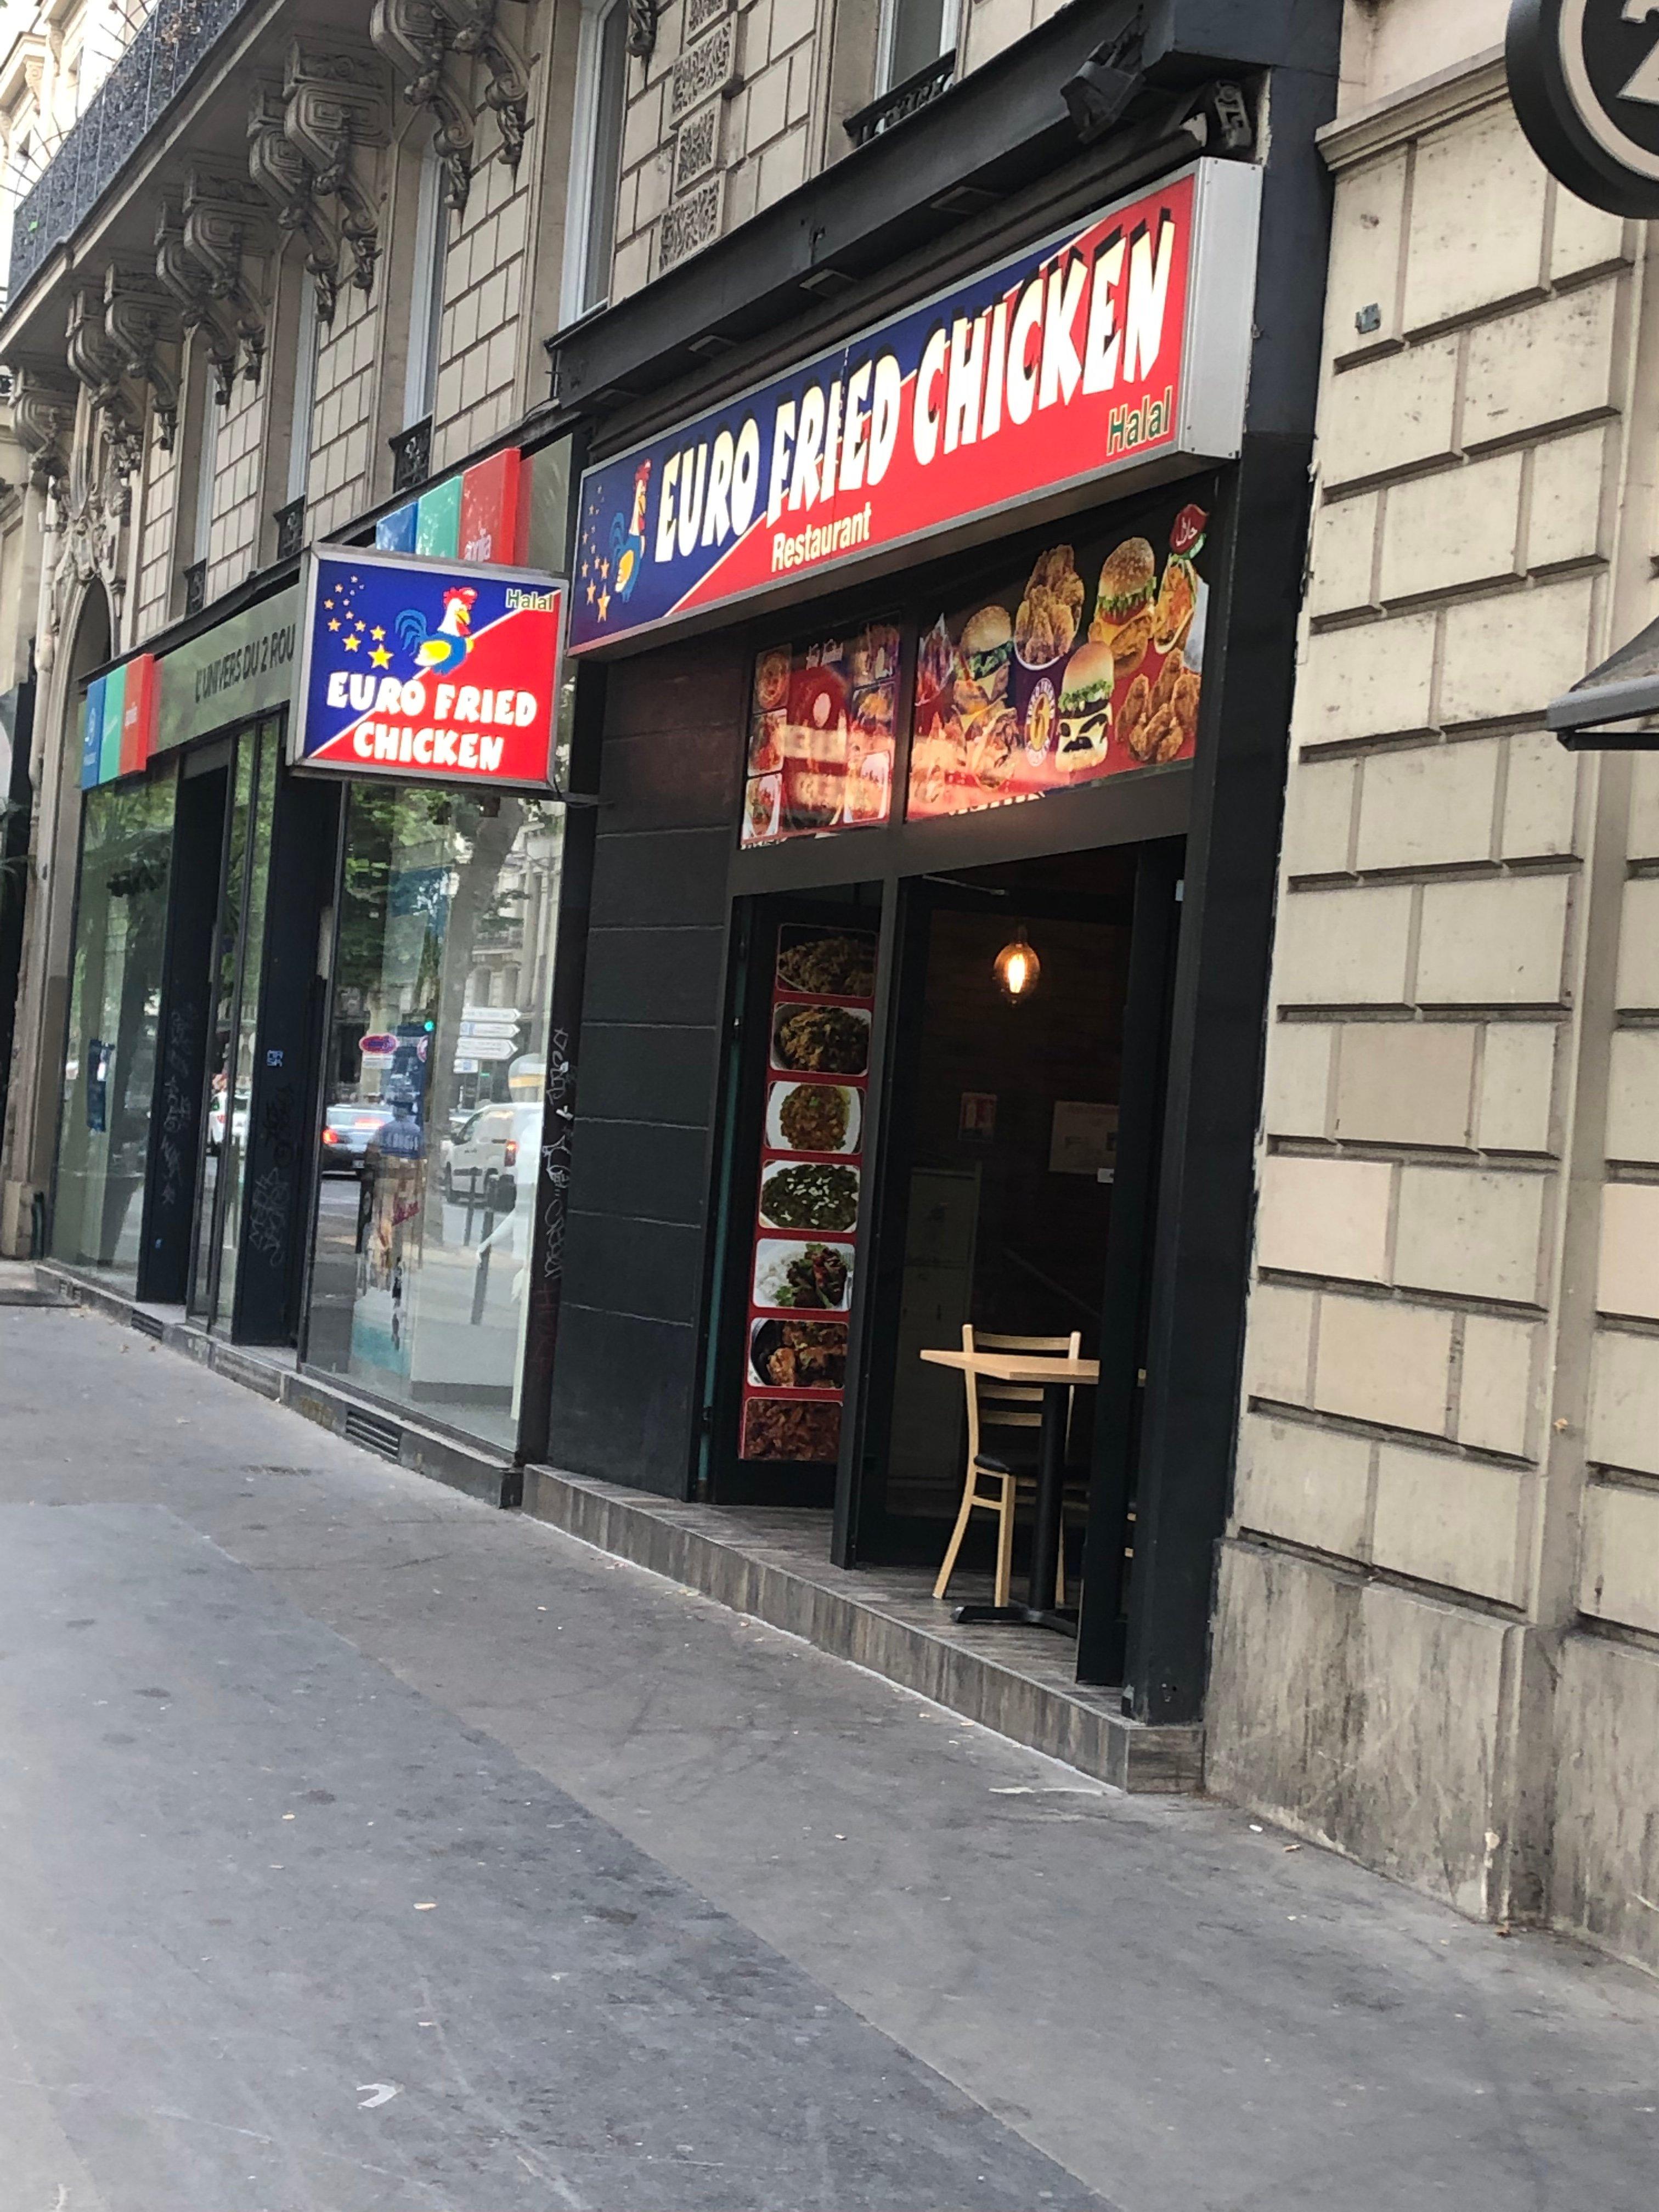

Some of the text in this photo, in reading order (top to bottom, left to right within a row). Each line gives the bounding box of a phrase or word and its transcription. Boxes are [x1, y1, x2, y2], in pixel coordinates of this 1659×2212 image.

[654, 219, 1176, 563] EURO FRIED CHICKEN
[1105, 385, 1173, 456] Halal
[771, 501, 872, 573] Restaurant
[505, 588, 554, 612] Halal
[242, 640, 260, 680] DU
[261, 636, 268, 673] 2
[326, 672, 538, 727] EURO FRIED
[352, 721, 504, 771] CHICKEN
